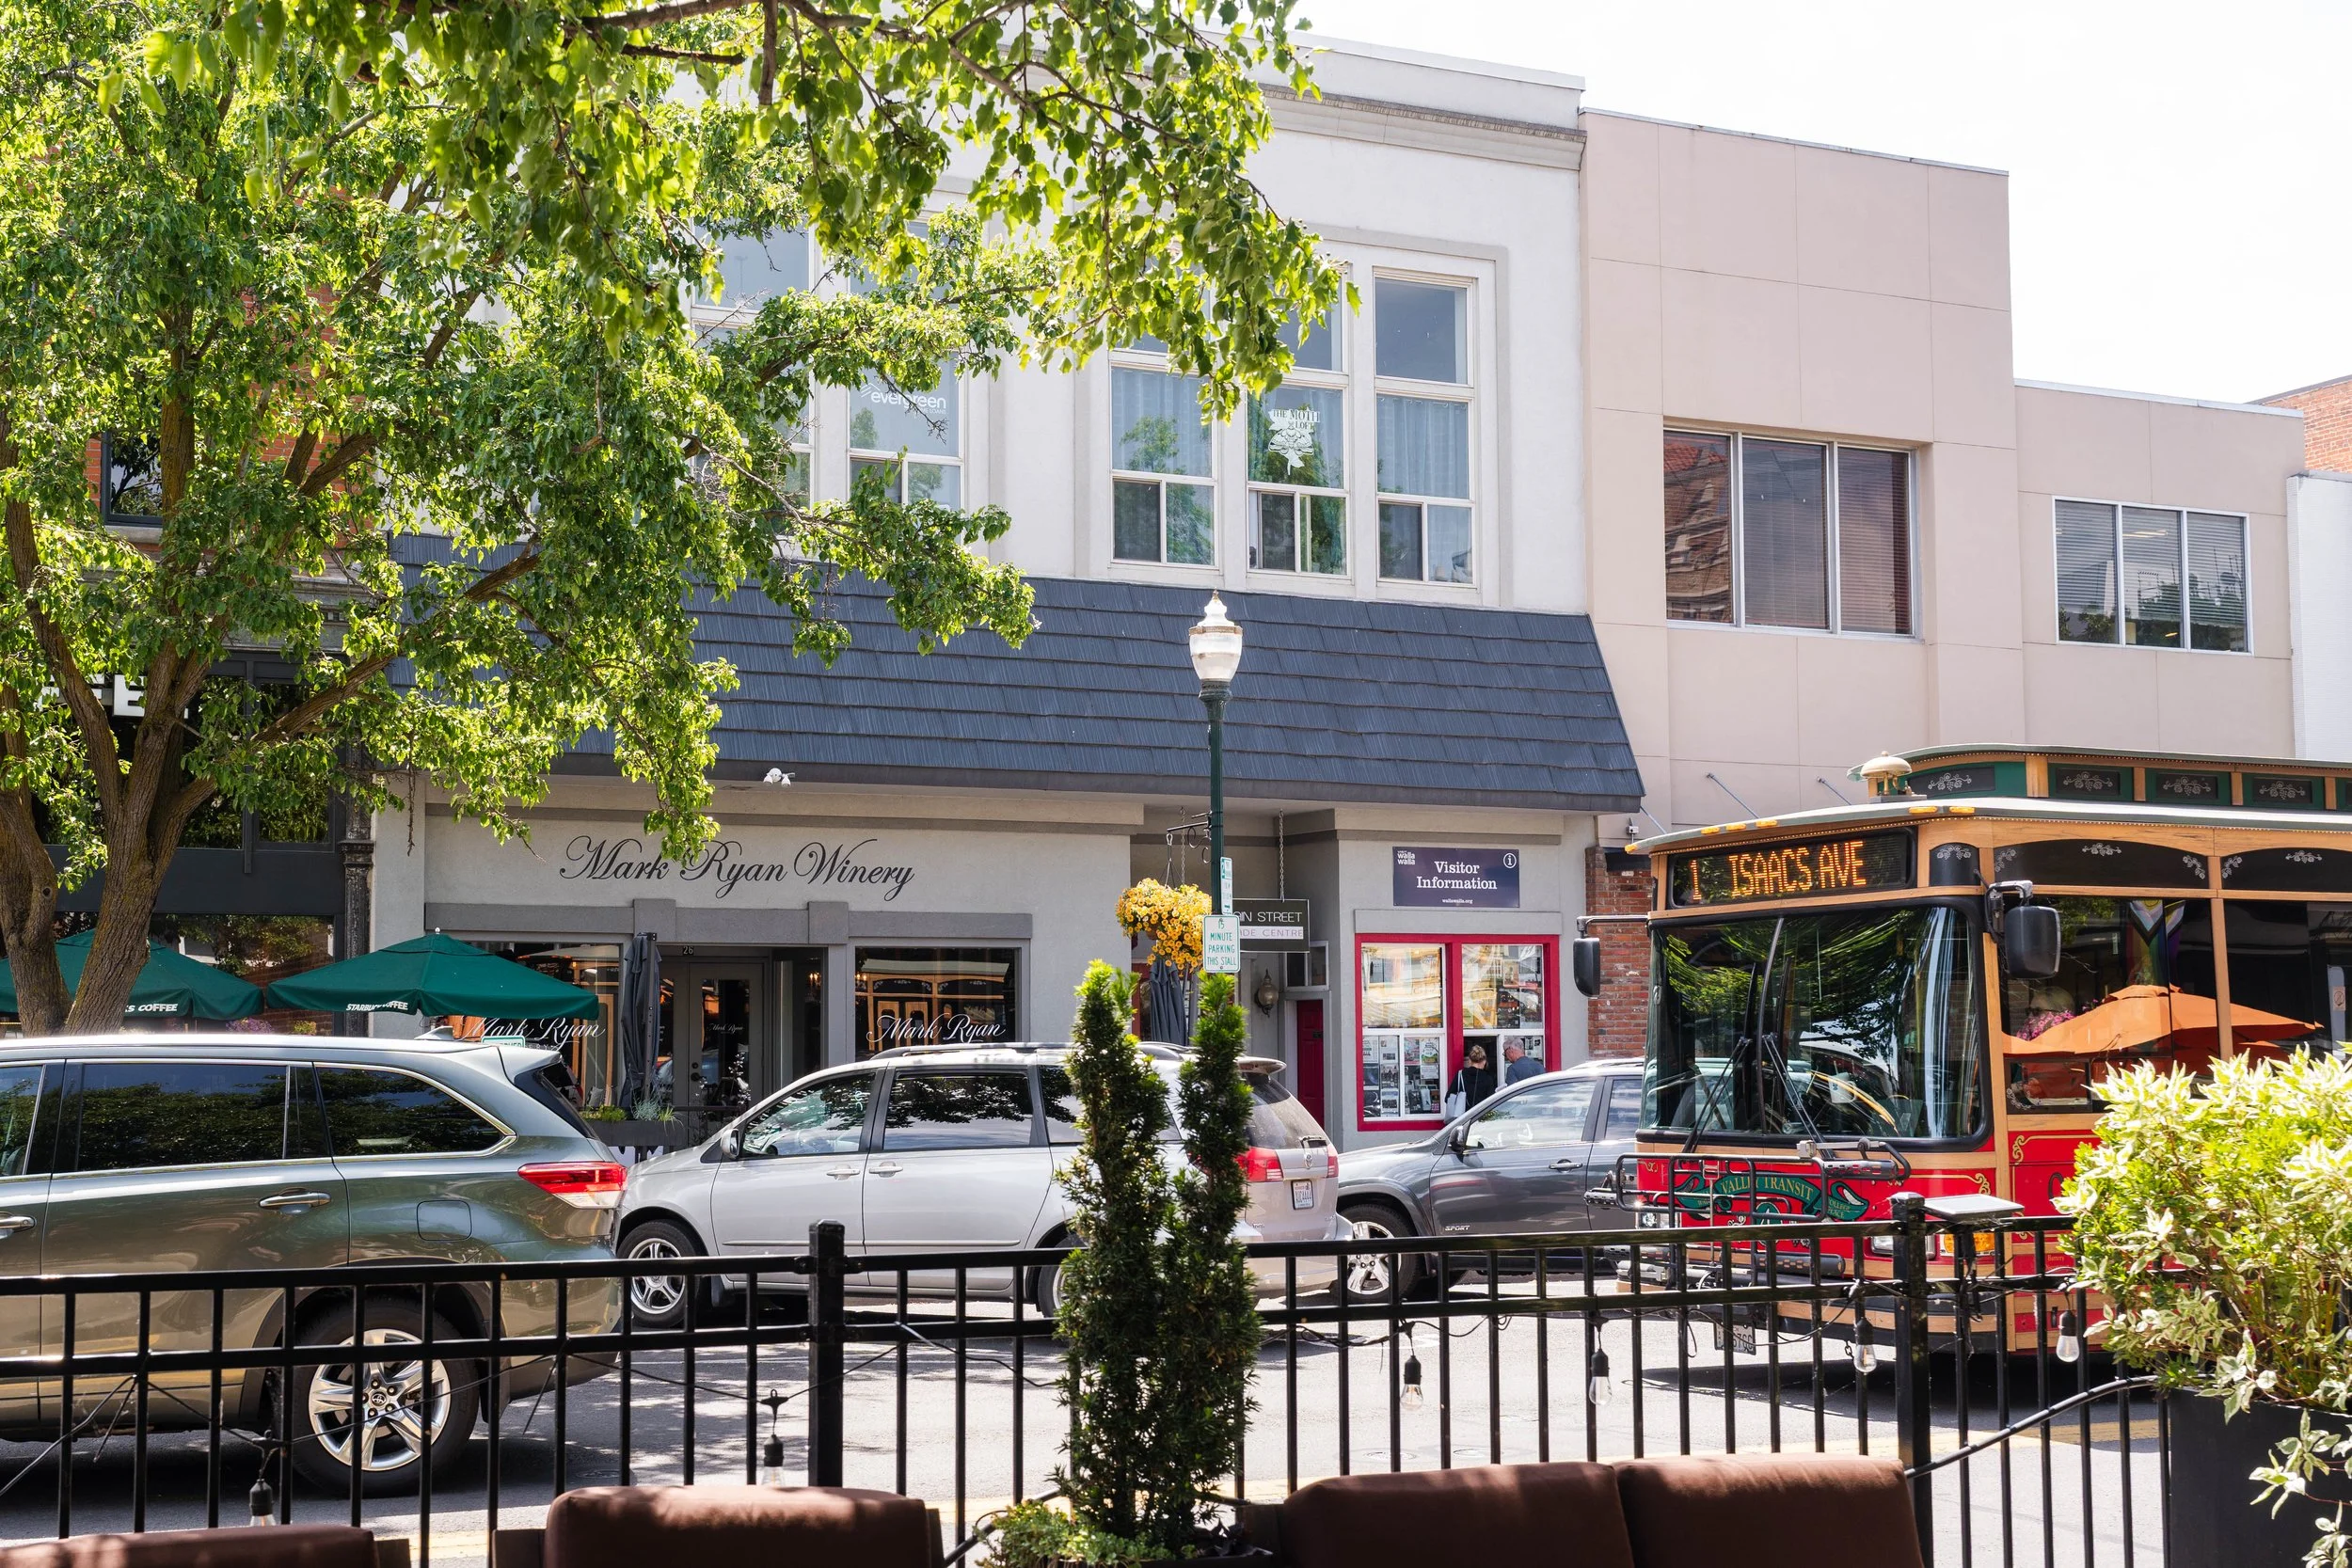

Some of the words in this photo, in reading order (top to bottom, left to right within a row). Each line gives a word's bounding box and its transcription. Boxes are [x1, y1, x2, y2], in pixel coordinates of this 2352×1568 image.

[871, 391, 946, 409] evergreen
[1272, 409, 1288, 419] THE
[1289, 409, 1321, 422] MOTH
[559, 835, 669, 880] Mark
[679, 840, 787, 899] Ryan
[793, 839, 915, 902] Winery
[1434, 861, 1480, 874] Visitor
[1690, 859, 1702, 901] 1
[1728, 847, 1812, 896] ISAACS
[1819, 841, 1867, 889] AVE
[1416, 876, 1498, 890] Information
[1233, 911, 1252, 922] IN
[1257, 911, 1302, 923] STREET
[1217, 919, 1225, 930] 15
[1210, 932, 1232, 942] MINUTE
[1263, 928, 1303, 938] CENTRE
[683, 945, 693, 955] 26
[1208, 944, 1235, 954] PARKING
[1207, 957, 1219, 965] THIS
[1221, 957, 1237, 966] STALL
[137, 1003, 179, 1012] COFFEE
[866, 1012, 950, 1043] Mark
[943, 1013, 1007, 1043] Ryan
[455, 1017, 534, 1041] Mark
[534, 1017, 606, 1052] Ryan
[1720, 1176, 1760, 1195] VALLY
[1764, 1176, 1814, 1201] TRANSIT
[1828, 1198, 1851, 1212] OLLEGE
